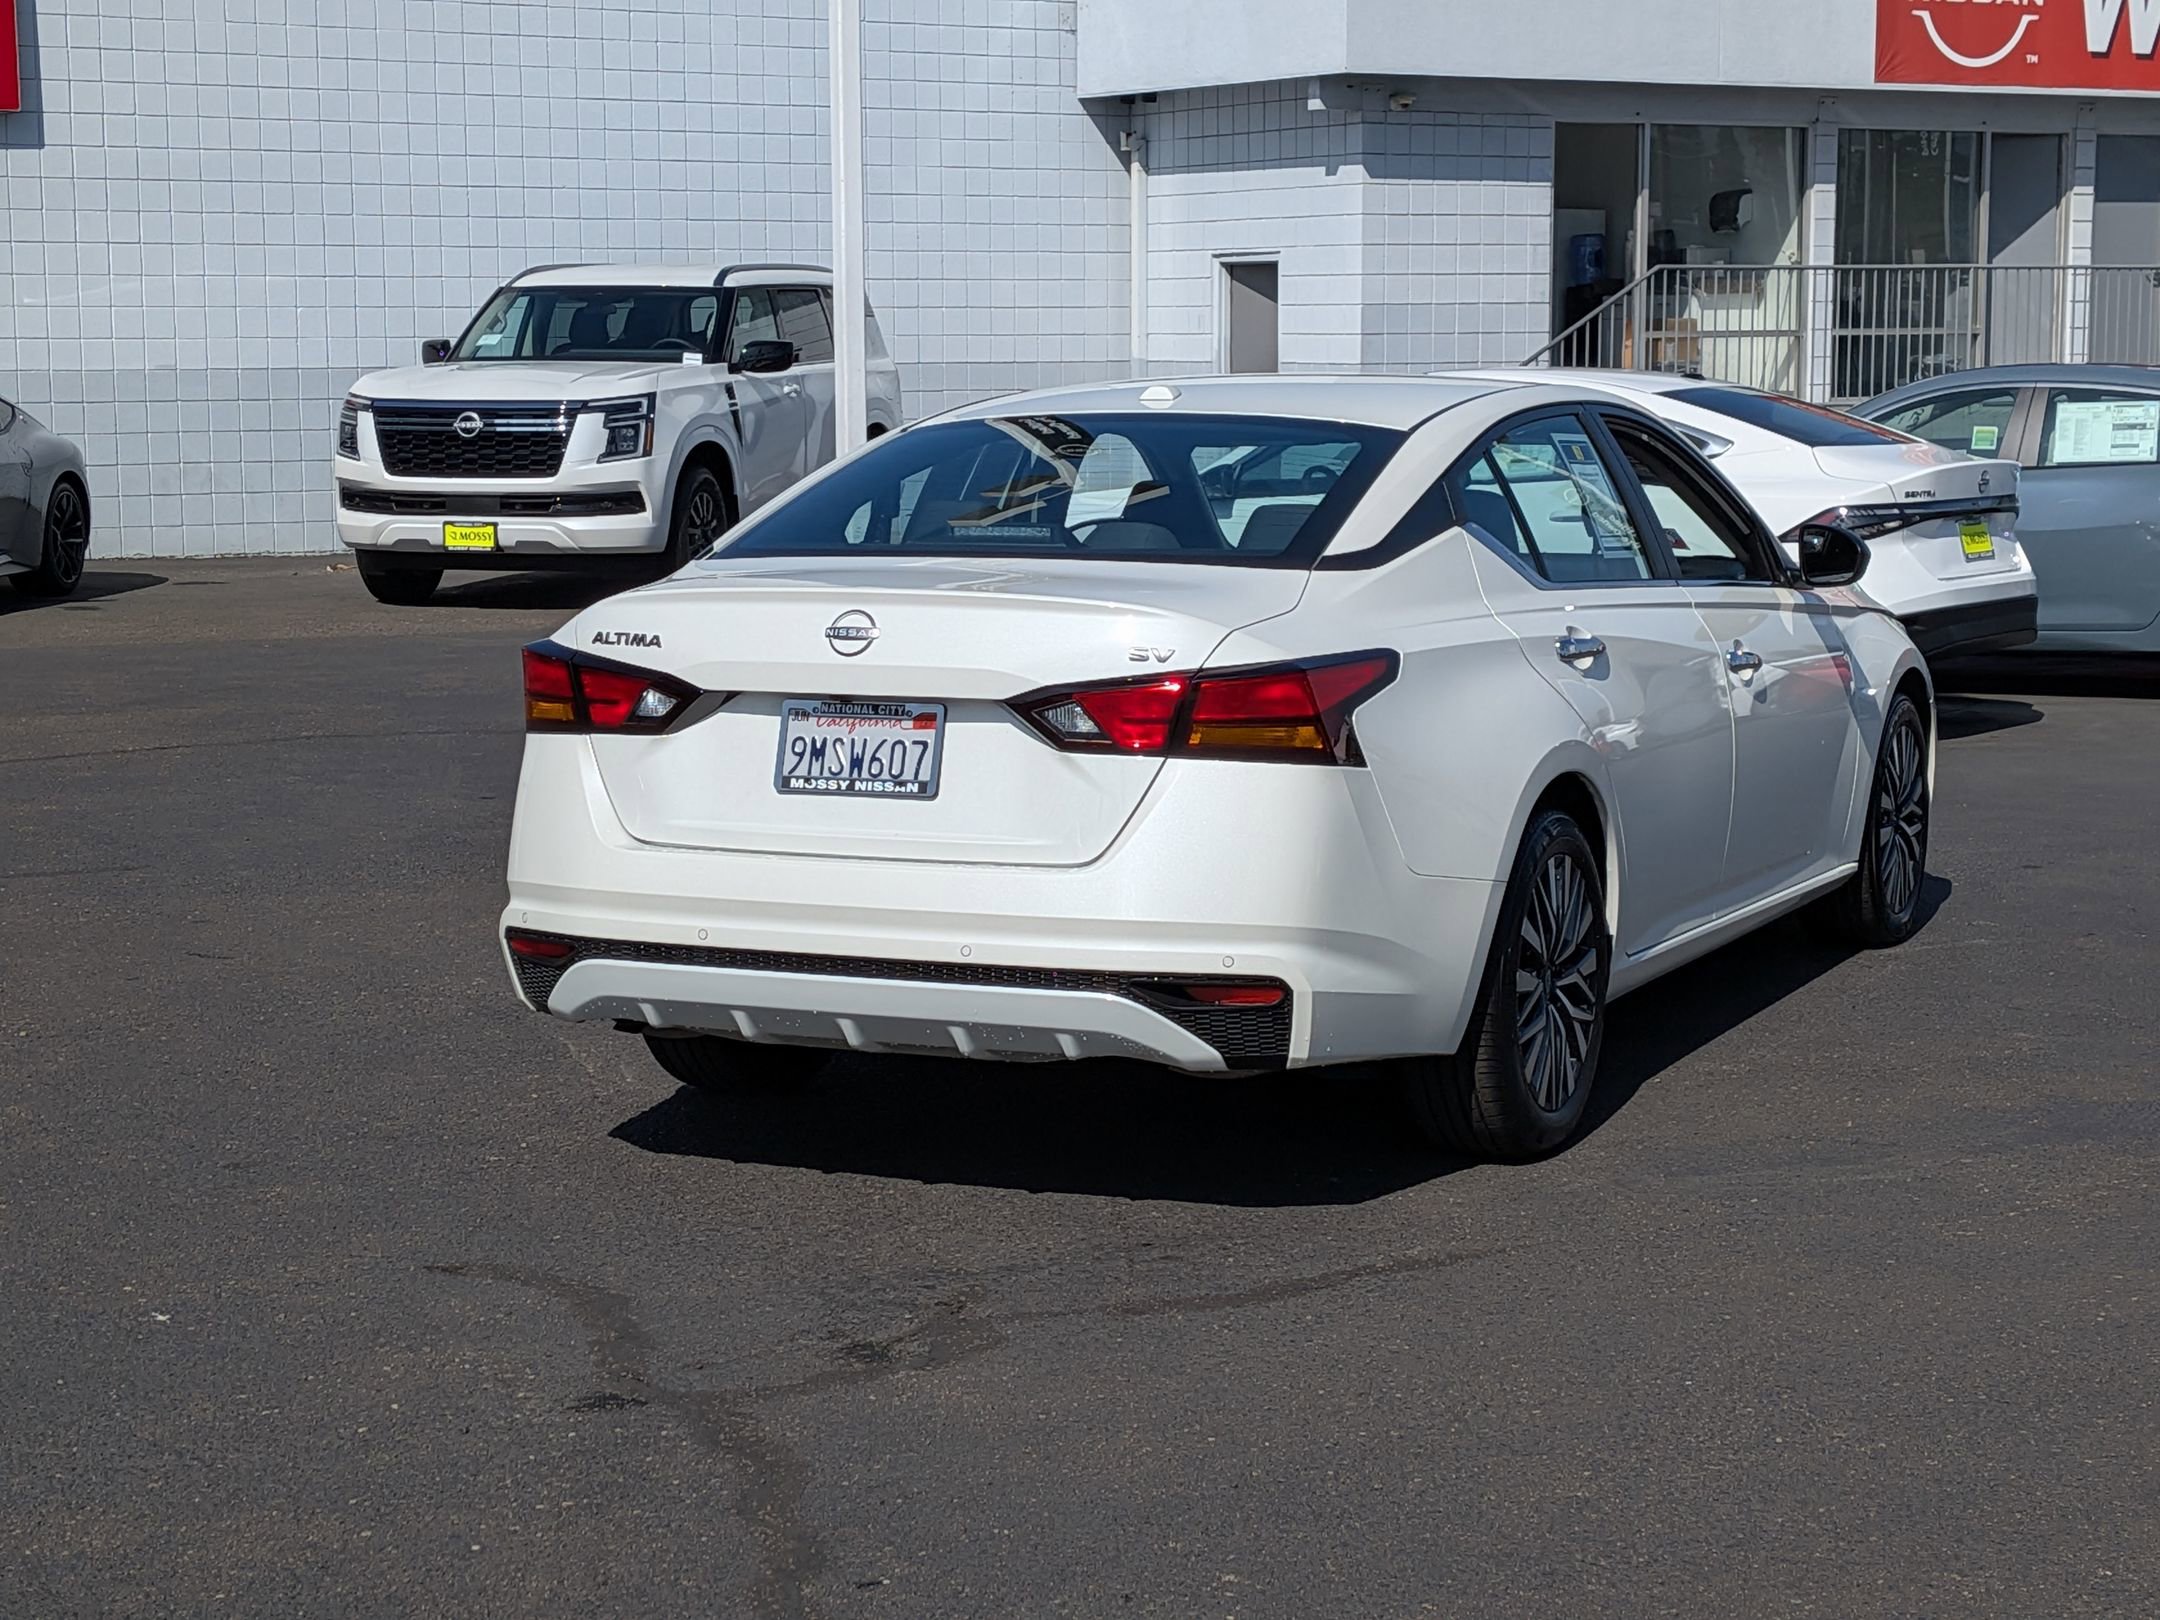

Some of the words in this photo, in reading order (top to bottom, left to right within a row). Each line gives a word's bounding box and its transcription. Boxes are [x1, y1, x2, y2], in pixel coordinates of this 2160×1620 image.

[459, 531, 493, 541] MOSSY
[591, 631, 662, 648] ALTIMA
[826, 628, 879, 637] NISSA
[1128, 646, 1176, 663] SV
[820, 702, 875, 715] NATIONAL
[878, 704, 906, 716] CITY
[788, 735, 929, 780] 9MSW607
[790, 778, 850, 790] MOSSY
